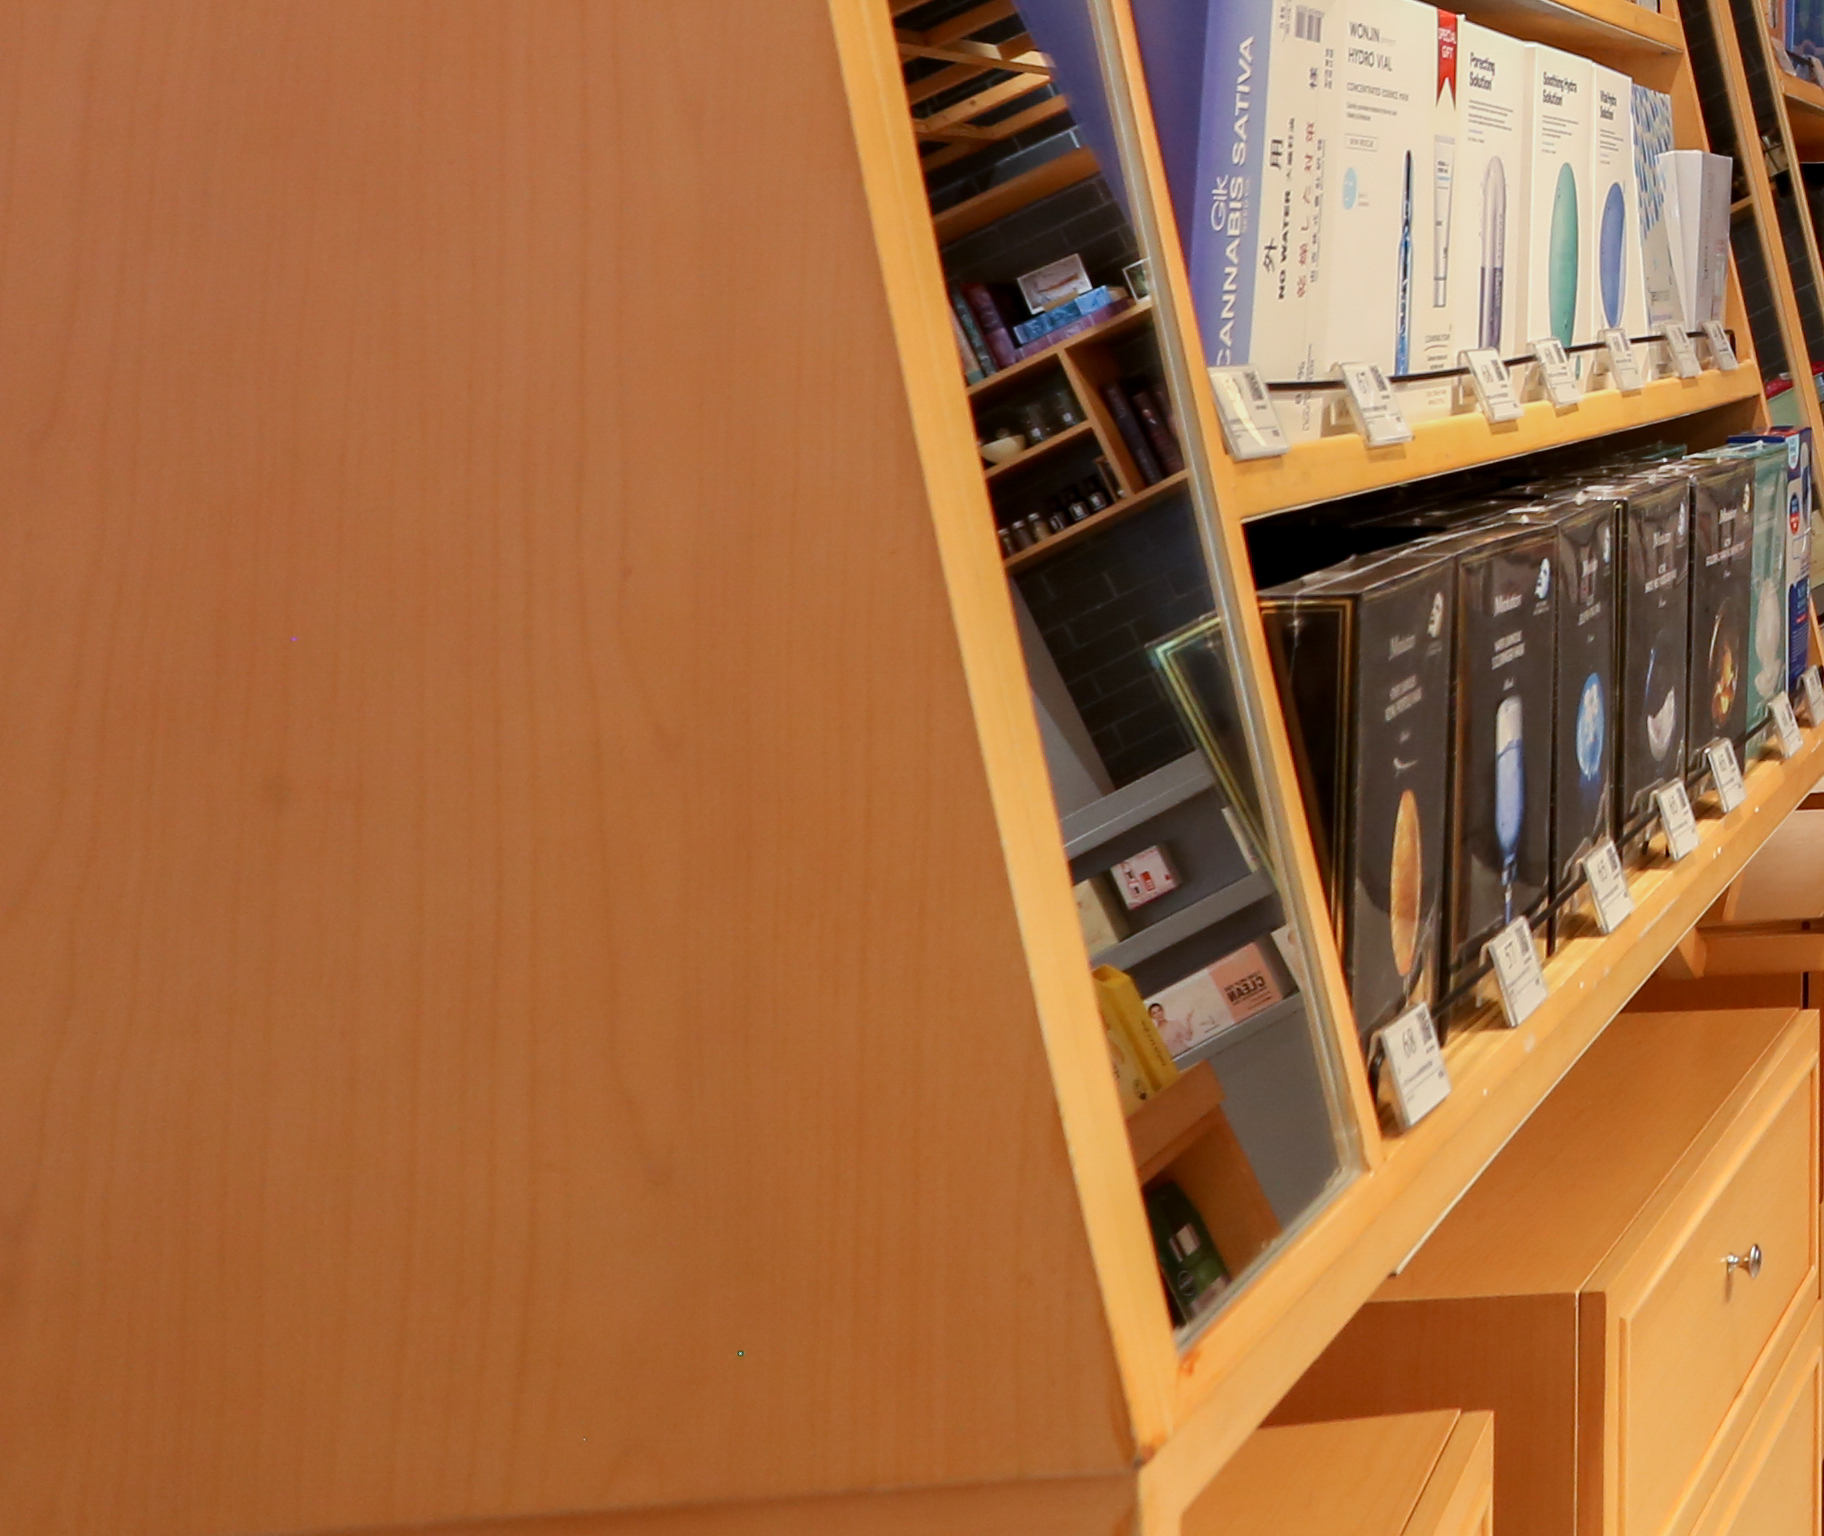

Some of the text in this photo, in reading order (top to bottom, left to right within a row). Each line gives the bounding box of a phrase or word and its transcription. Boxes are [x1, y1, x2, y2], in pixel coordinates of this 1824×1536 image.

[1348, 47, 1375, 68] HYDRO
[1470, 71, 1492, 91] Solution
[1231, 35, 1255, 166] SATIVA
[1211, 175, 1229, 231] Gik
[1216, 176, 1245, 367] CANNABIS
[1278, 190, 1292, 300] NO WATER
[1402, 1027, 1417, 1058] 68
